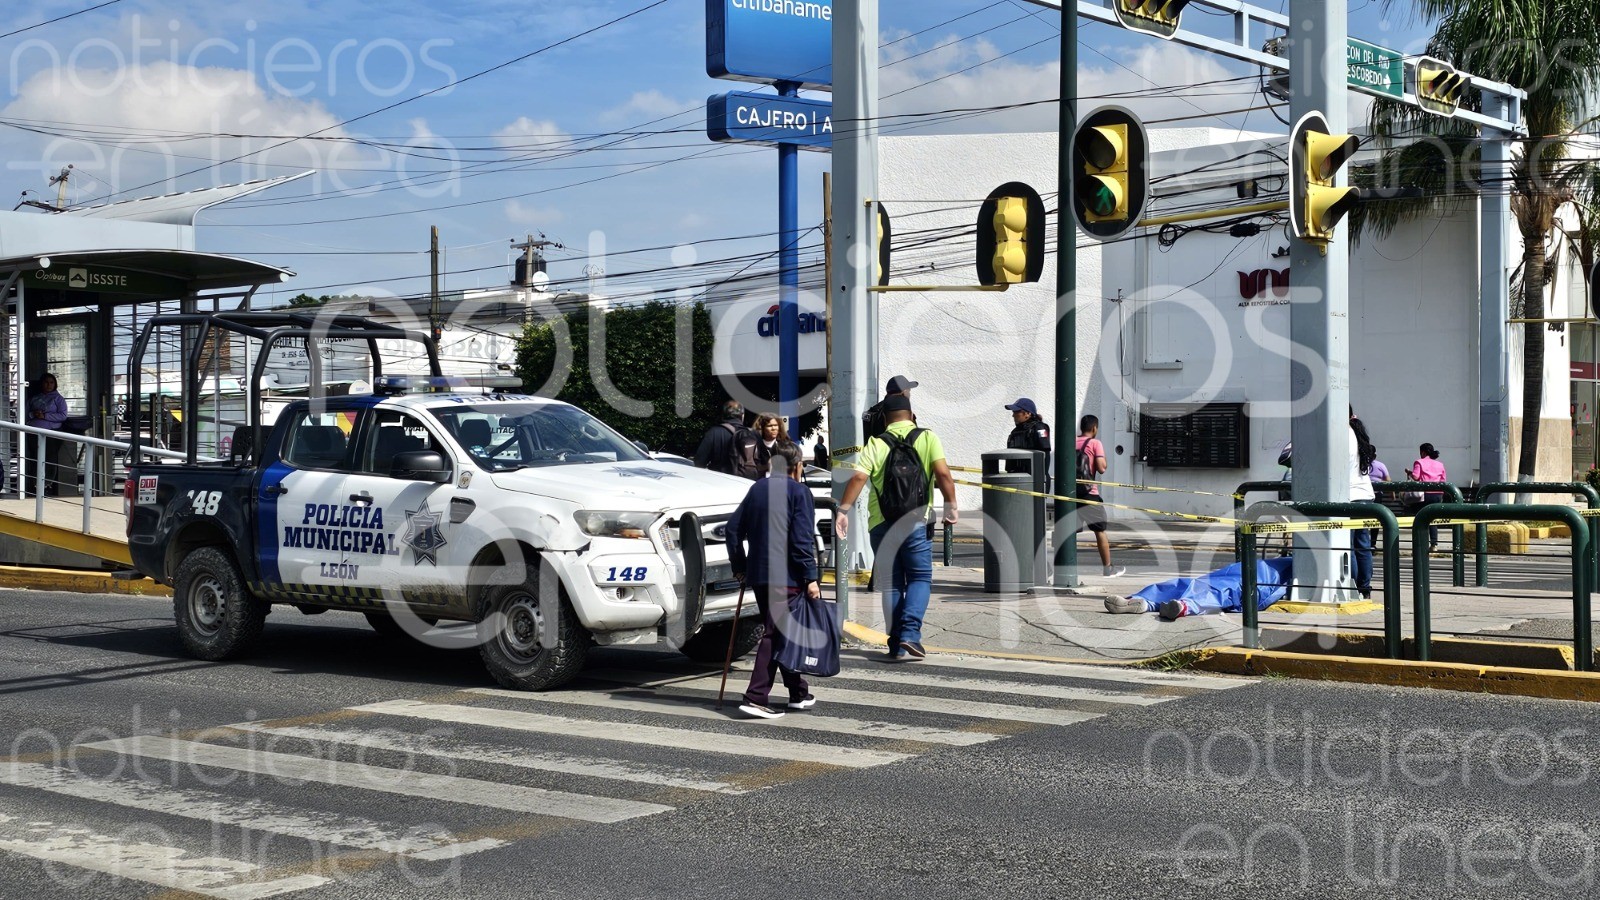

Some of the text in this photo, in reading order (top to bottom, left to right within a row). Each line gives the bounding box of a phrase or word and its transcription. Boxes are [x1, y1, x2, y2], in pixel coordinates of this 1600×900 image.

[731, 0, 832, 21] citibaname
[1347, 45, 1361, 61] CON
[1363, 49, 1376, 66] DEL
[736, 106, 832, 133] CAJERO A
[89, 273, 127, 286] ISSSTE
[283, 526, 400, 556] MUNICIPAL
[320, 558, 360, 580] LEÓN
[606, 566, 648, 582] 148
